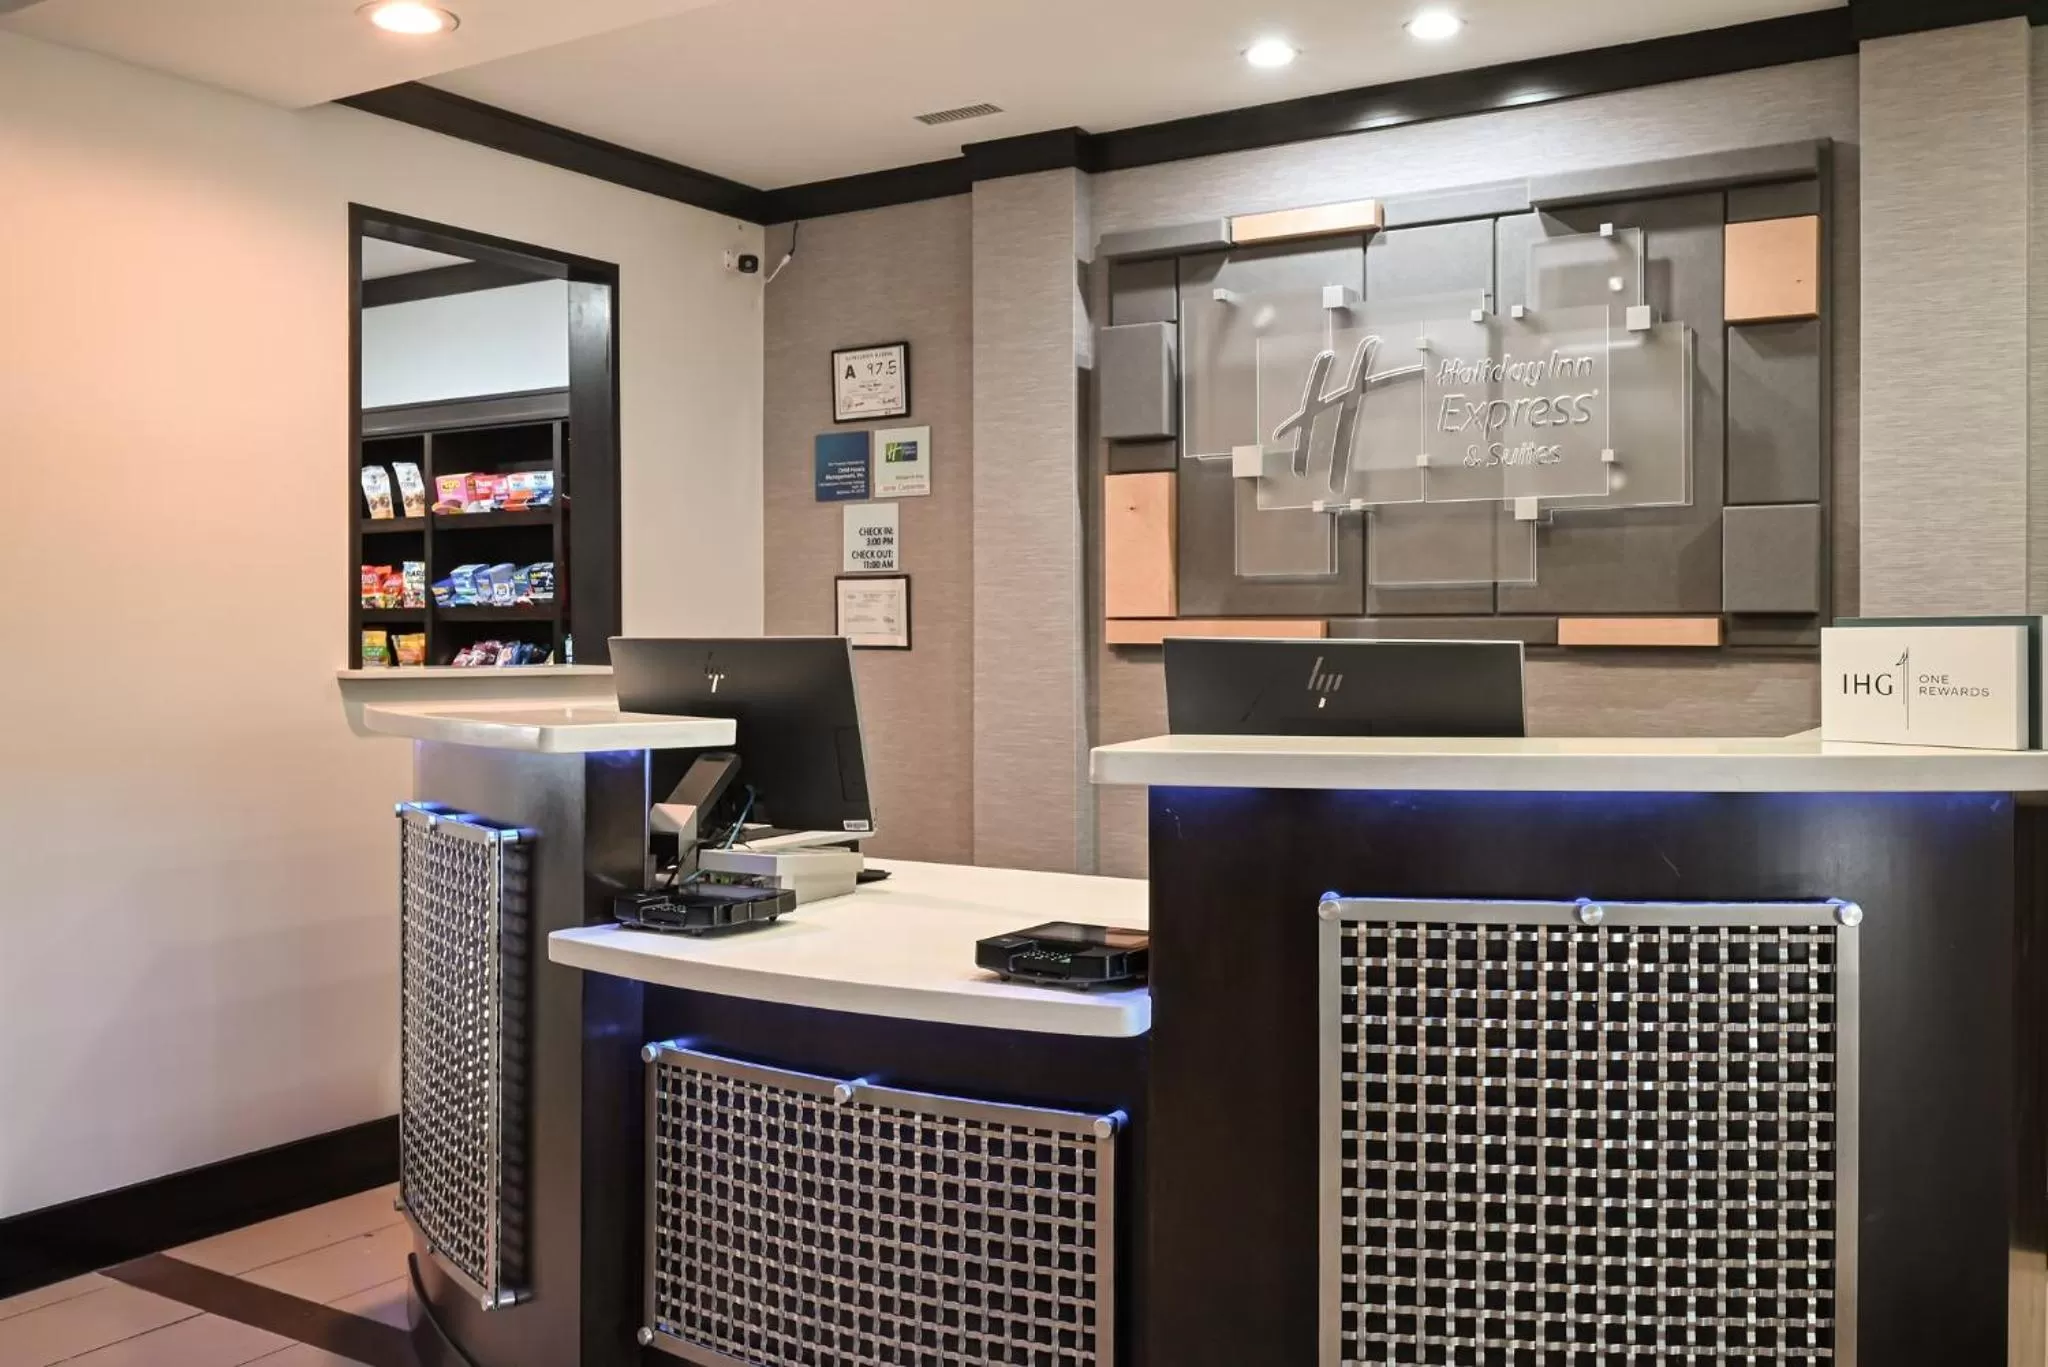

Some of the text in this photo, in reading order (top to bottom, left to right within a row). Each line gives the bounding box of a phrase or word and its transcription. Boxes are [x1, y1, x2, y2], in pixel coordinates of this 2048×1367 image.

[845, 364, 856, 379] A
[1436, 349, 1594, 387] Holiday Inn
[1436, 392, 1595, 441] Express
[1463, 441, 1563, 467] & Suites
[858, 526, 882, 536] CHECK
[882, 537, 894, 545] PM
[851, 549, 875, 560] CHECK
[863, 560, 894, 569] 11:00 AM
[1843, 673, 1893, 696] IHG
[1918, 674, 1949, 685] ONE
[1918, 686, 1990, 697] REWARDS
